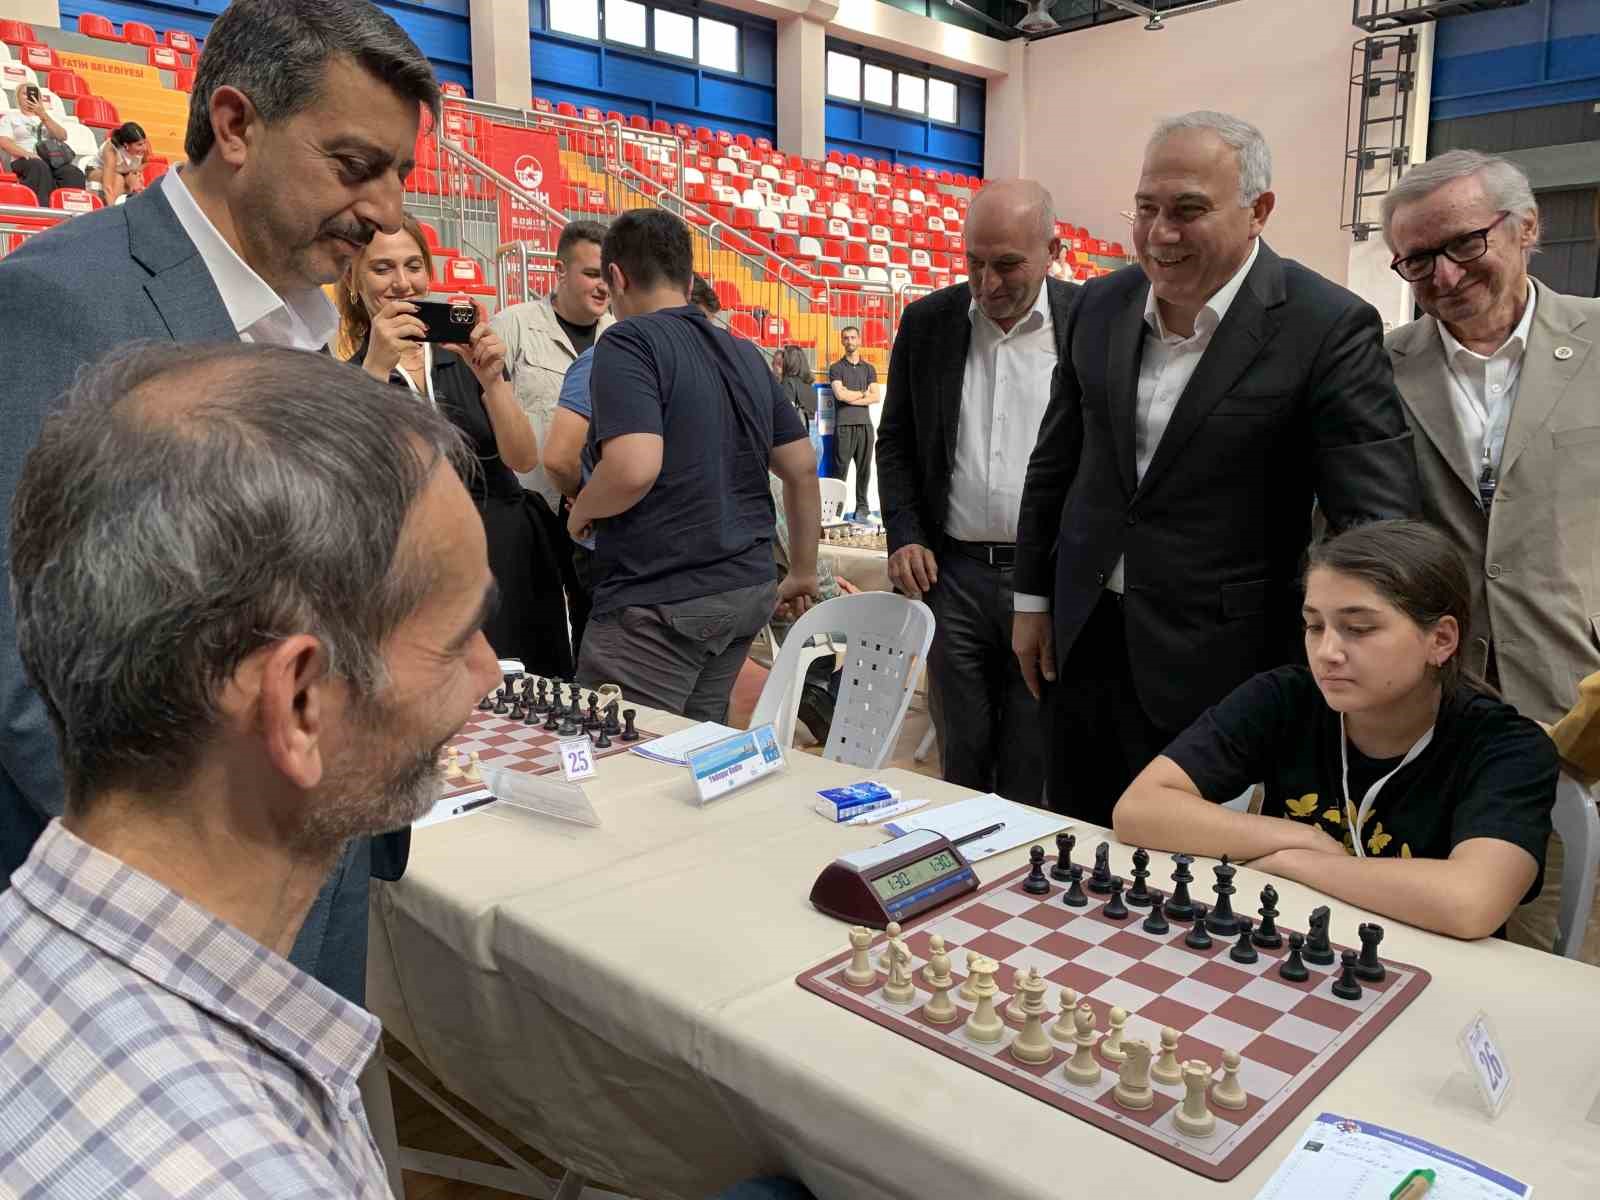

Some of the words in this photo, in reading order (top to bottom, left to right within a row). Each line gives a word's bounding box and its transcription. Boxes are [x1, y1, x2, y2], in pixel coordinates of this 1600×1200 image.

[568, 750, 589, 773] 25
[888, 871, 911, 890] 1:30
[929, 854, 953, 872] 1:30
[1479, 1041, 1503, 1091] 26
